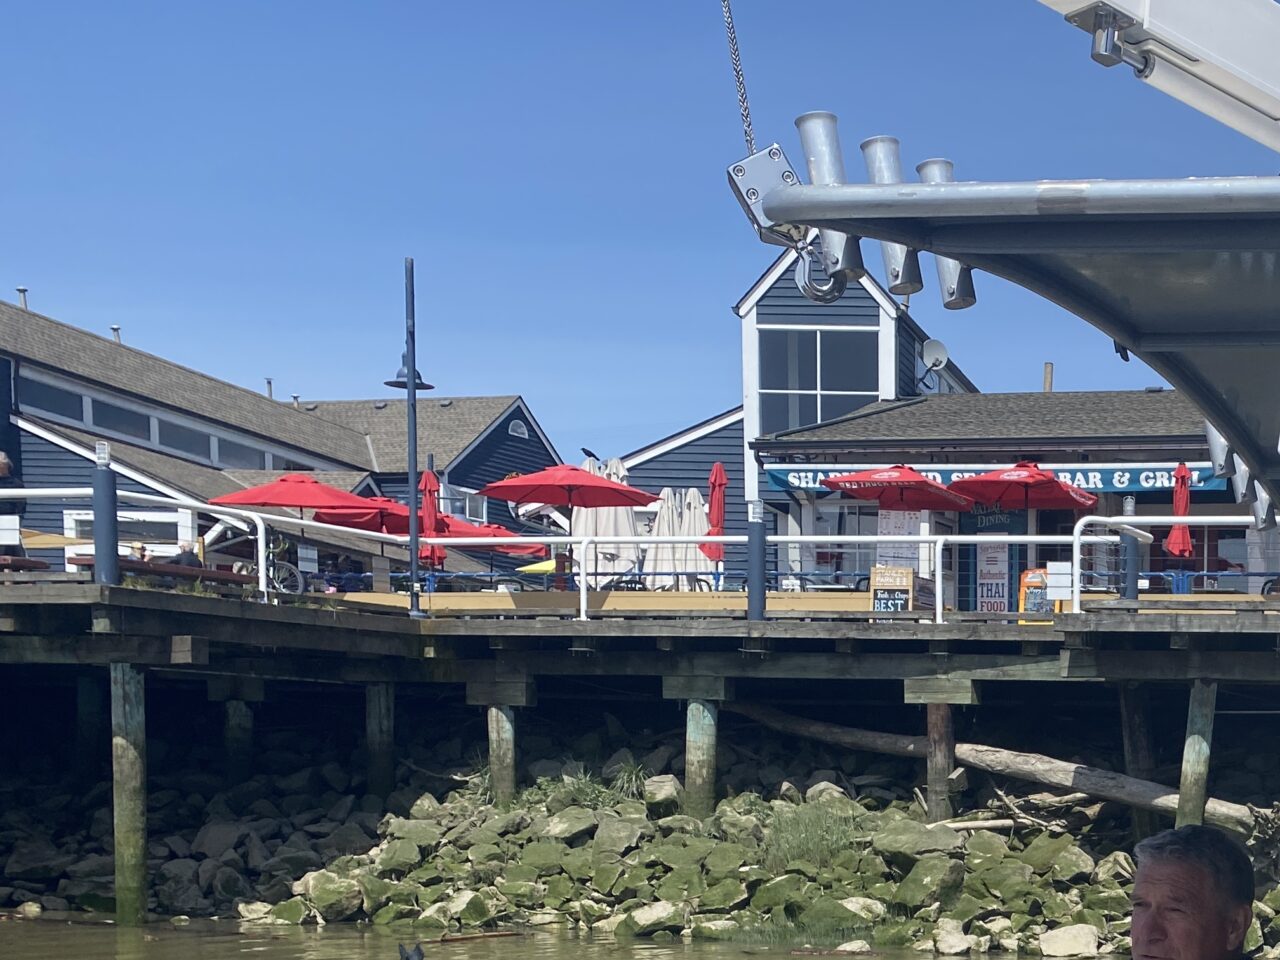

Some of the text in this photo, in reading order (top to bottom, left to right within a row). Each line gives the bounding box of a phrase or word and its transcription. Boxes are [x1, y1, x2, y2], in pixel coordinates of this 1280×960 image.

[787, 471, 856, 488] SHA
[1057, 471, 1104, 489] BAR
[1112, 472, 1131, 488] &
[1139, 471, 1205, 488] GRL
[977, 513, 1011, 528] DINING
[978, 582, 1006, 599] THAI
[874, 600, 905, 612] BEST
[979, 600, 1006, 612] FOOD
